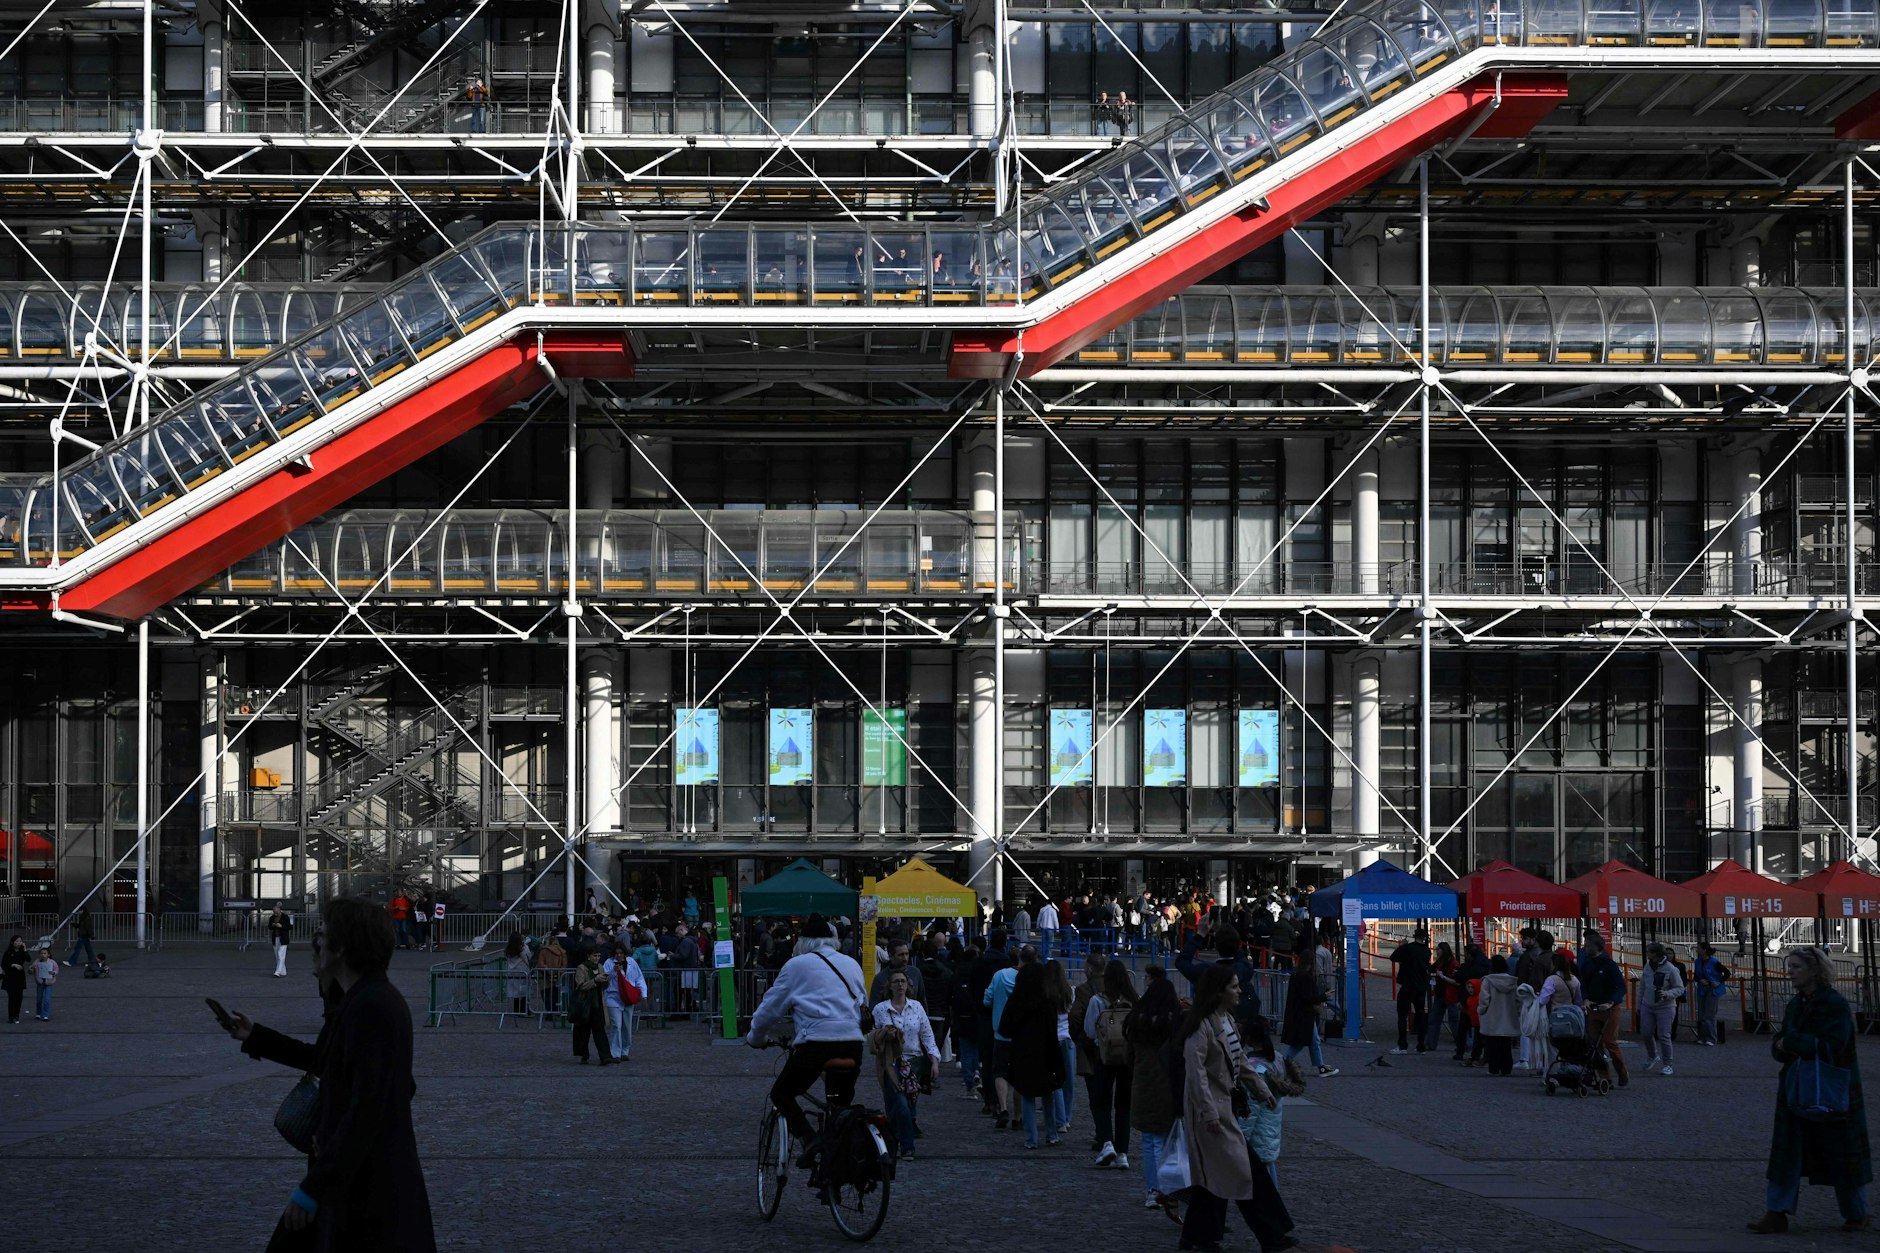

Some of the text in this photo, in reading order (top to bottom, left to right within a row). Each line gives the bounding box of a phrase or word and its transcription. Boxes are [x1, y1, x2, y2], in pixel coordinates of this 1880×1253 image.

[926, 895, 961, 905] Cinémas
[1360, 901, 1379, 911] Sans
[1380, 901, 1403, 911] billet
[1408, 901, 1420, 911] No
[1421, 901, 1442, 911] ticket
[1500, 901, 1546, 910] Prioritaires
